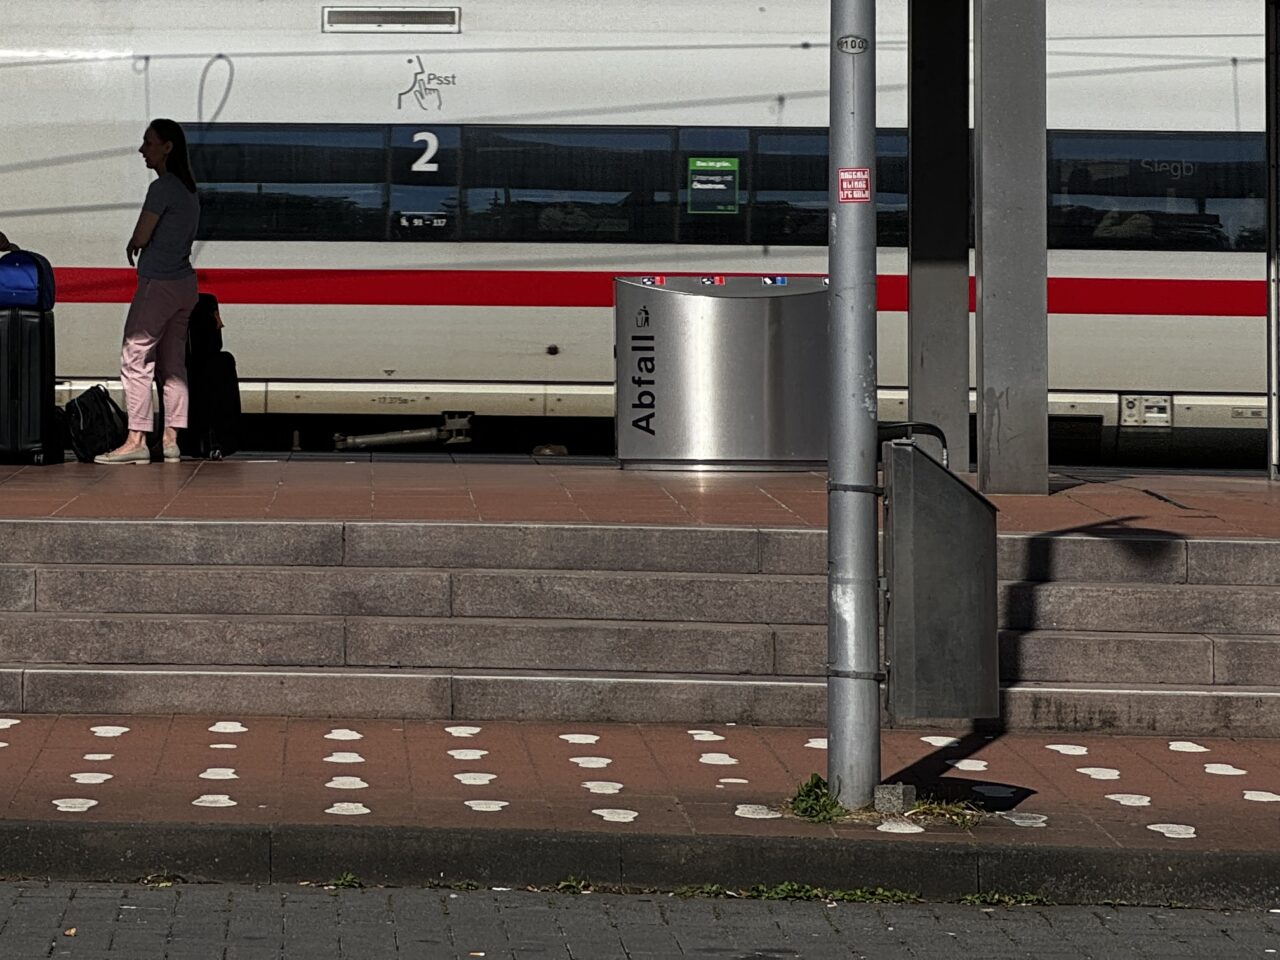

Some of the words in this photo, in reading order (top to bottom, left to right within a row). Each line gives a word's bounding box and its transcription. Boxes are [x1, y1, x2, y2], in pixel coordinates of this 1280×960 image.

[427, 72, 457, 86] Psst
[411, 131, 439, 172] 2
[1139, 158, 1198, 180] Siegb
[632, 334, 655, 436] Abfall
